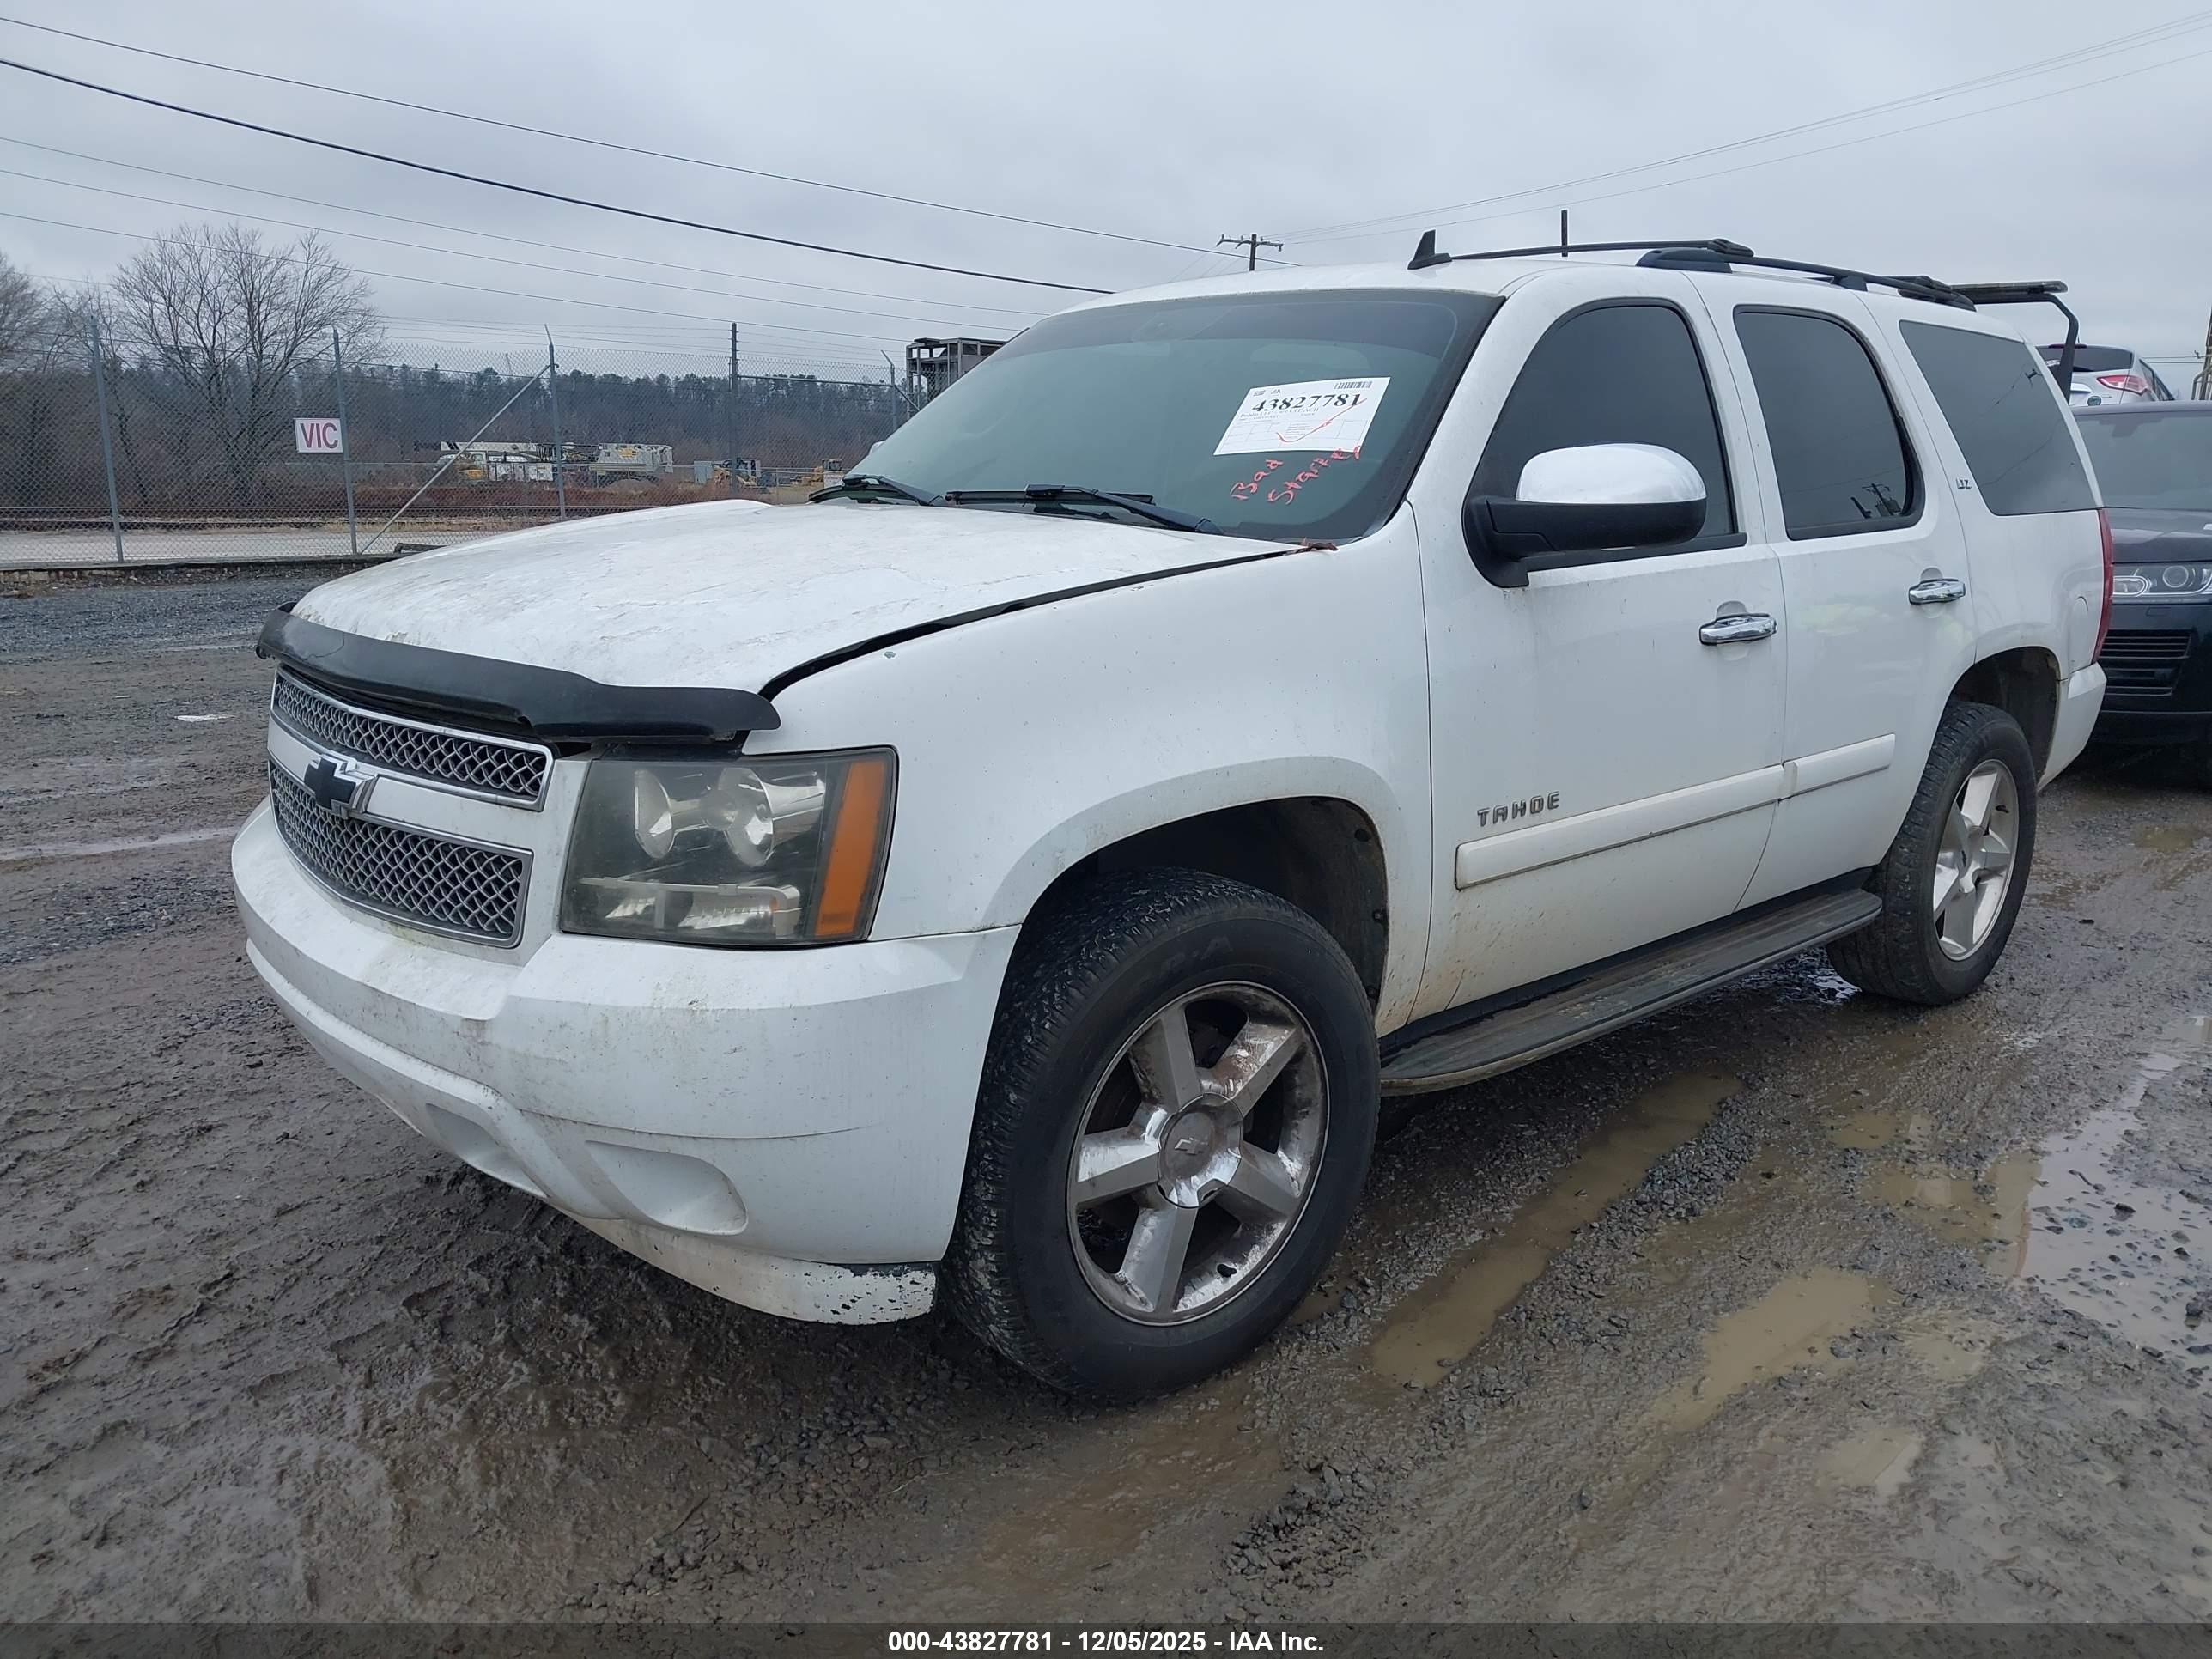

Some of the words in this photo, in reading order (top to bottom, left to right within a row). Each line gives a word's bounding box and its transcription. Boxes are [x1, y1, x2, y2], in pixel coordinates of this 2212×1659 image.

[1252, 392, 1362, 412] 43827781
[300, 422, 338, 448] VIC
[1230, 459, 1285, 501] Bad
[1477, 790, 1560, 827] TAHOE
